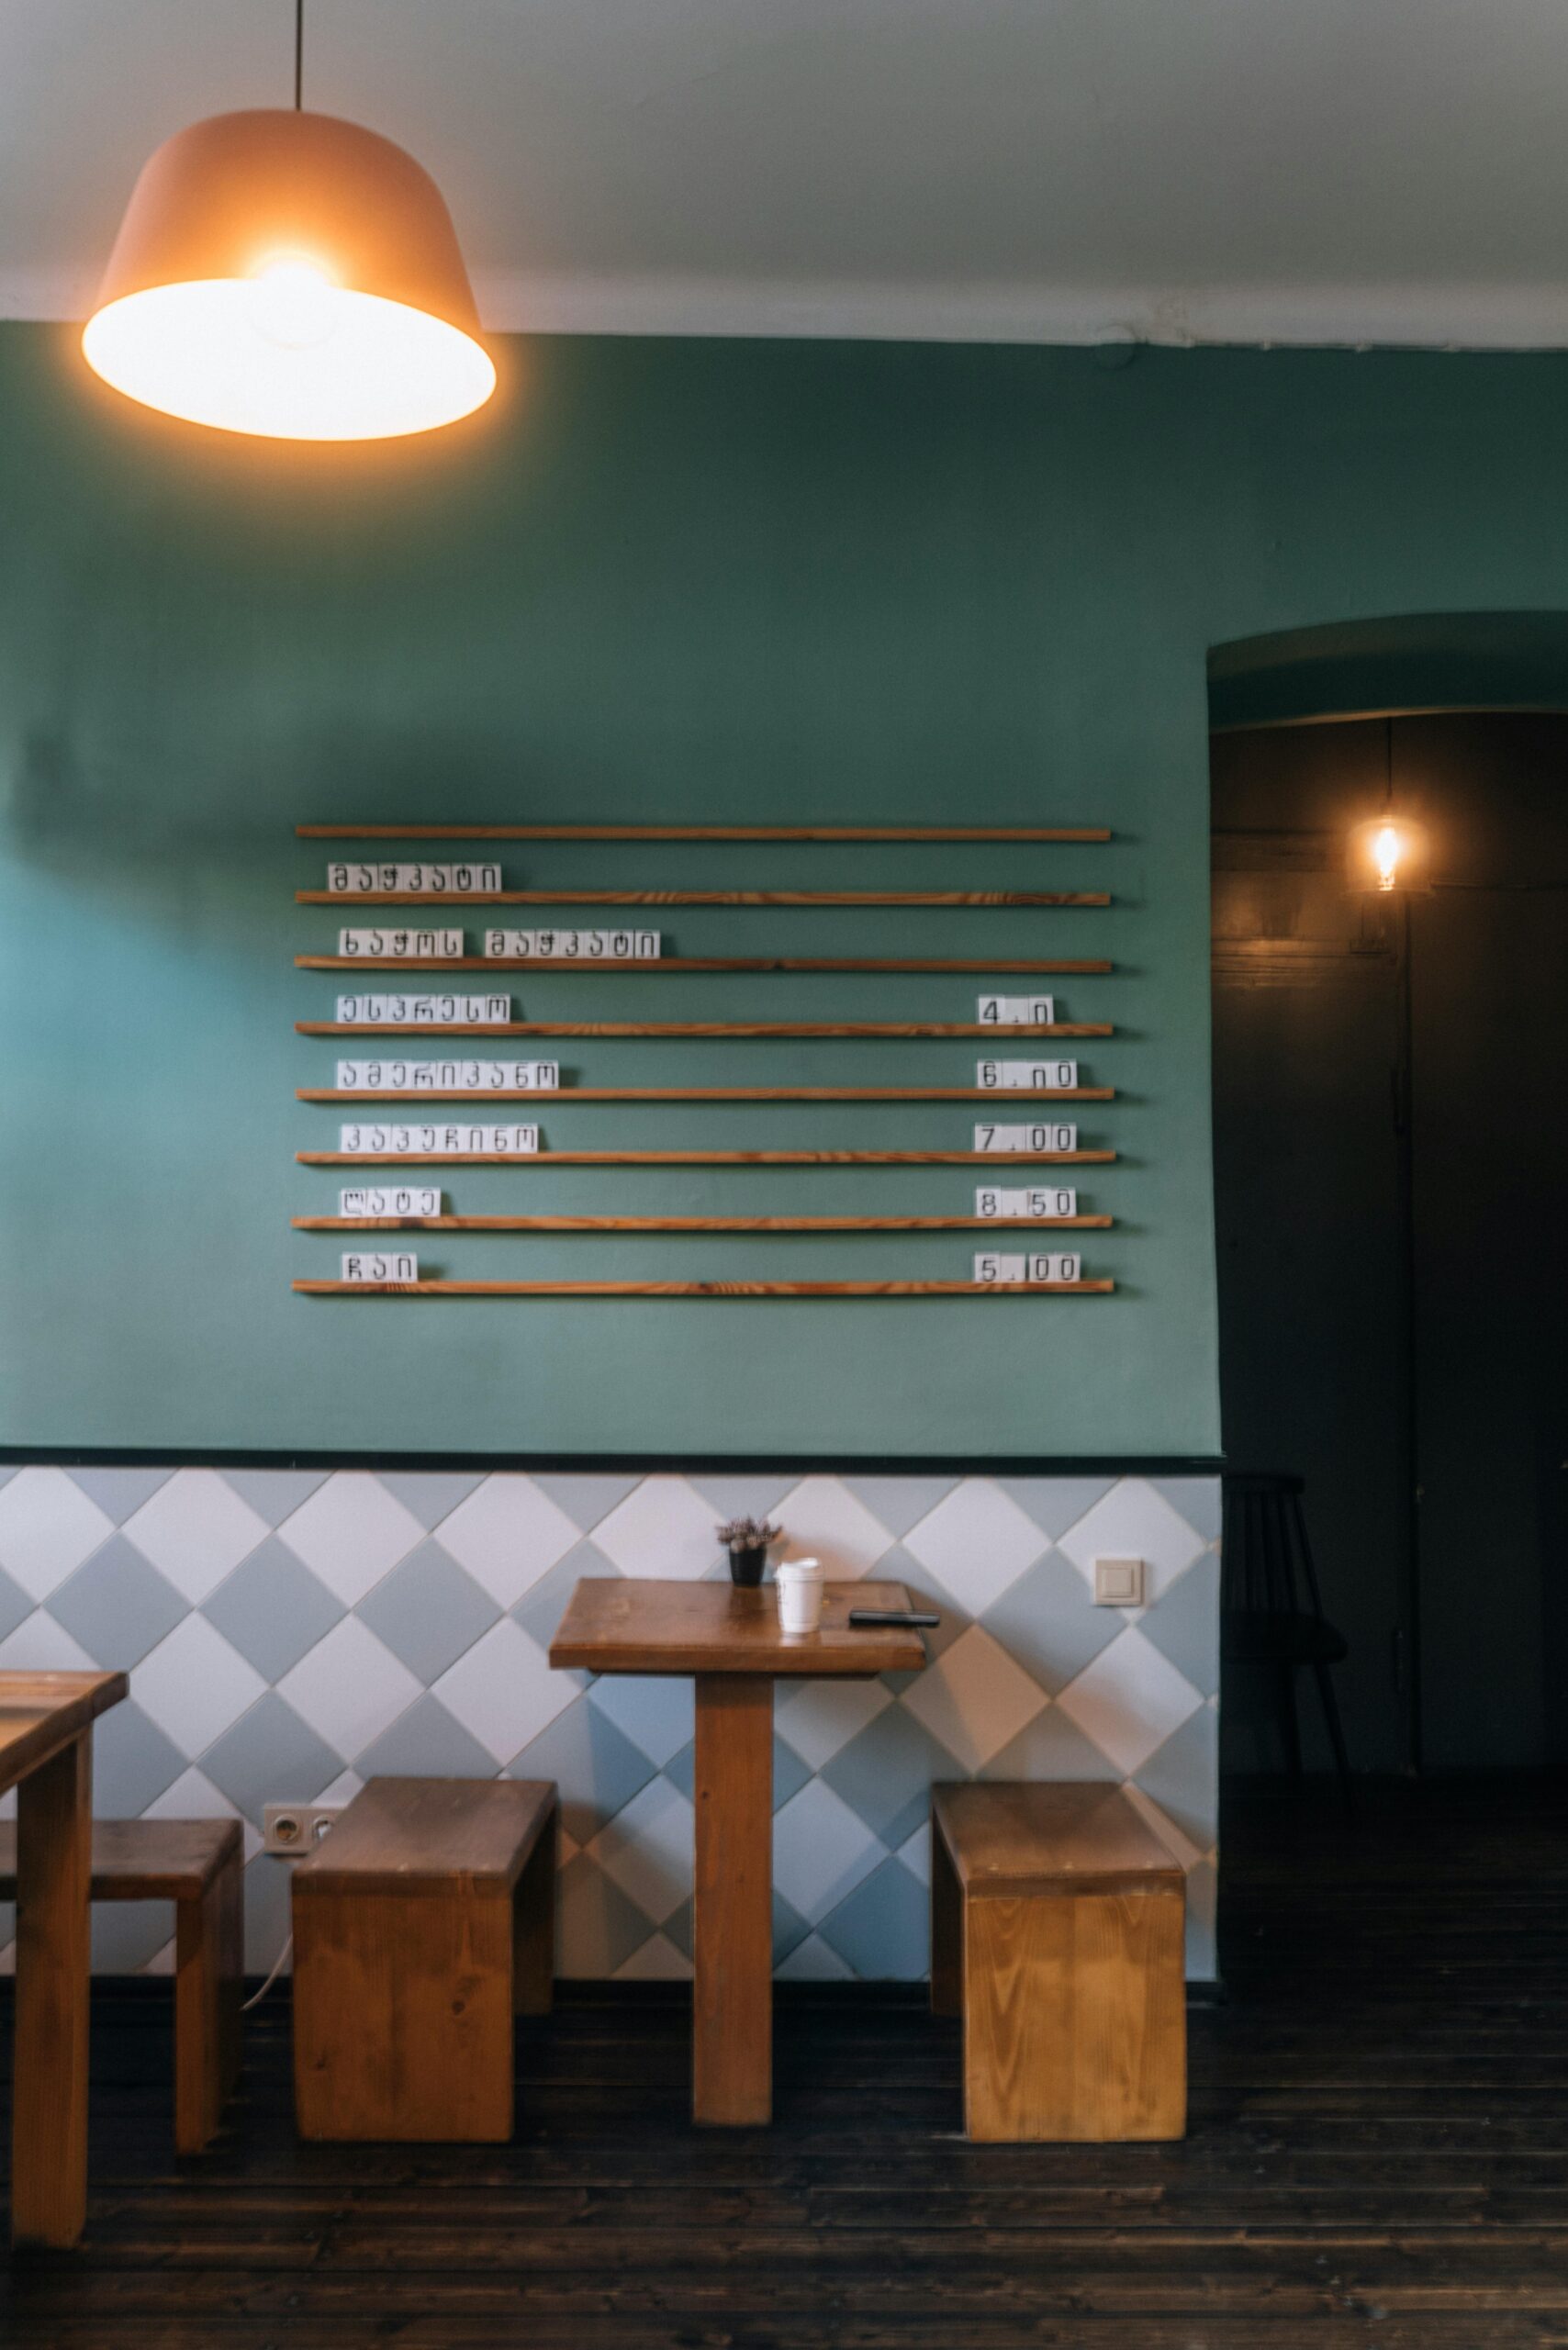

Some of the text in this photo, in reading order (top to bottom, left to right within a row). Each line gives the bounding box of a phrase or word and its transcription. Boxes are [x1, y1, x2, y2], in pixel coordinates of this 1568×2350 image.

[334, 864, 496, 891] მაჭკატი
[345, 929, 655, 957] ხაჭოს მაჭკატი
[343, 995, 507, 1022] ესპრესო
[343, 1061, 556, 1088] ამერიკანო
[347, 1125, 1071, 1152] კაპუჩინო 7.00
[344, 1189, 1070, 1216] ლატე 8.50
[348, 1254, 1075, 1281] ჩაი 5.00
